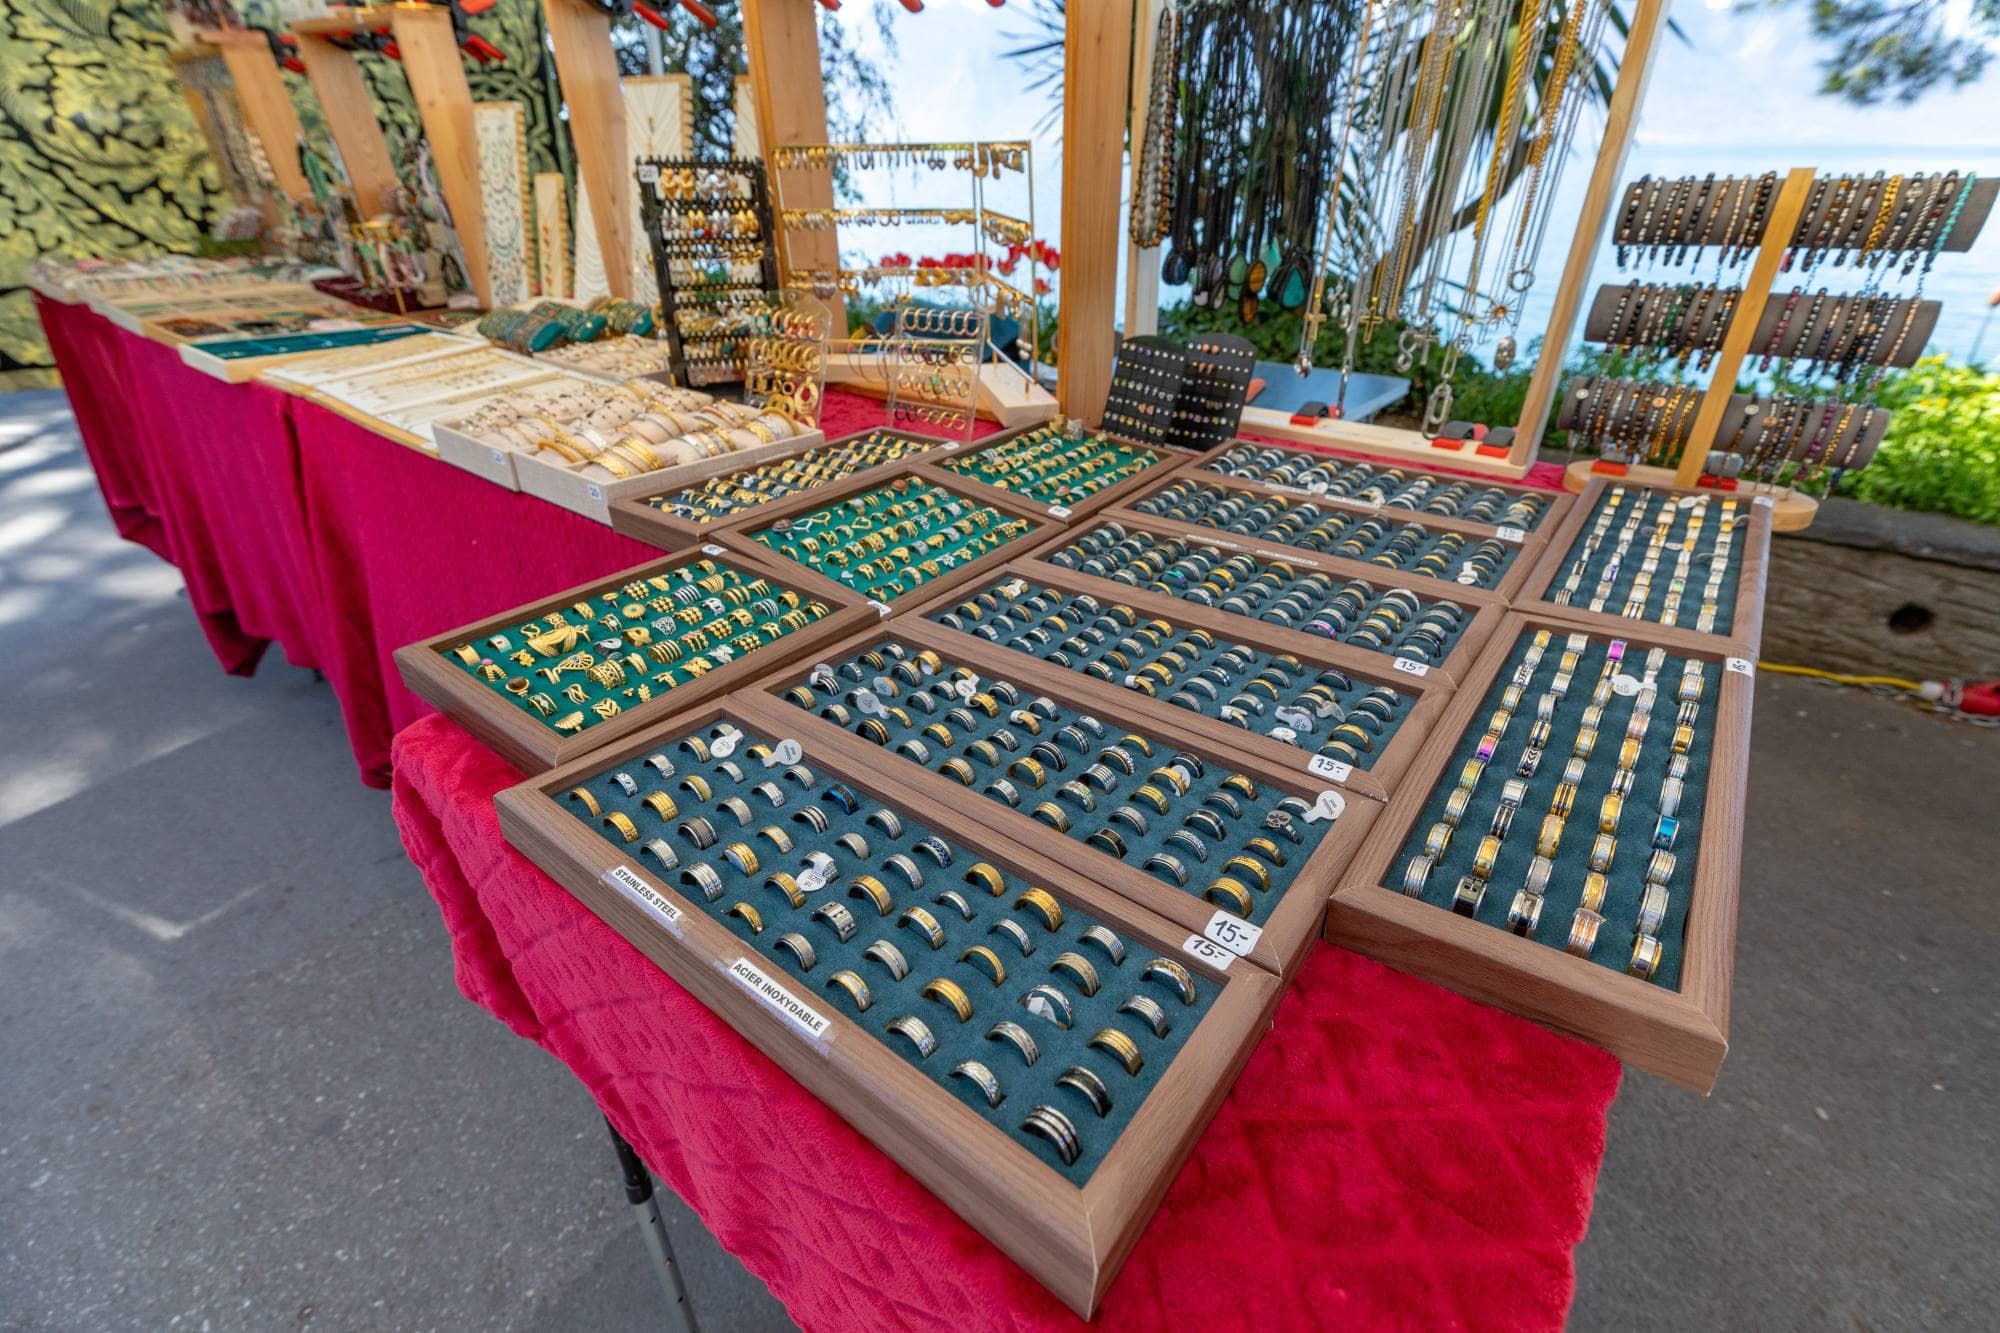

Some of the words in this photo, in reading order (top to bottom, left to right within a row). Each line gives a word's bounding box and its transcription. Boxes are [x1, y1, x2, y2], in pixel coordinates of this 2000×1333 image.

[615, 869, 655, 901] STAINLESS
[653, 897, 678, 919] STEEL
[733, 963, 763, 987] ACIER
[761, 982, 824, 1031] INOXYDABLE
